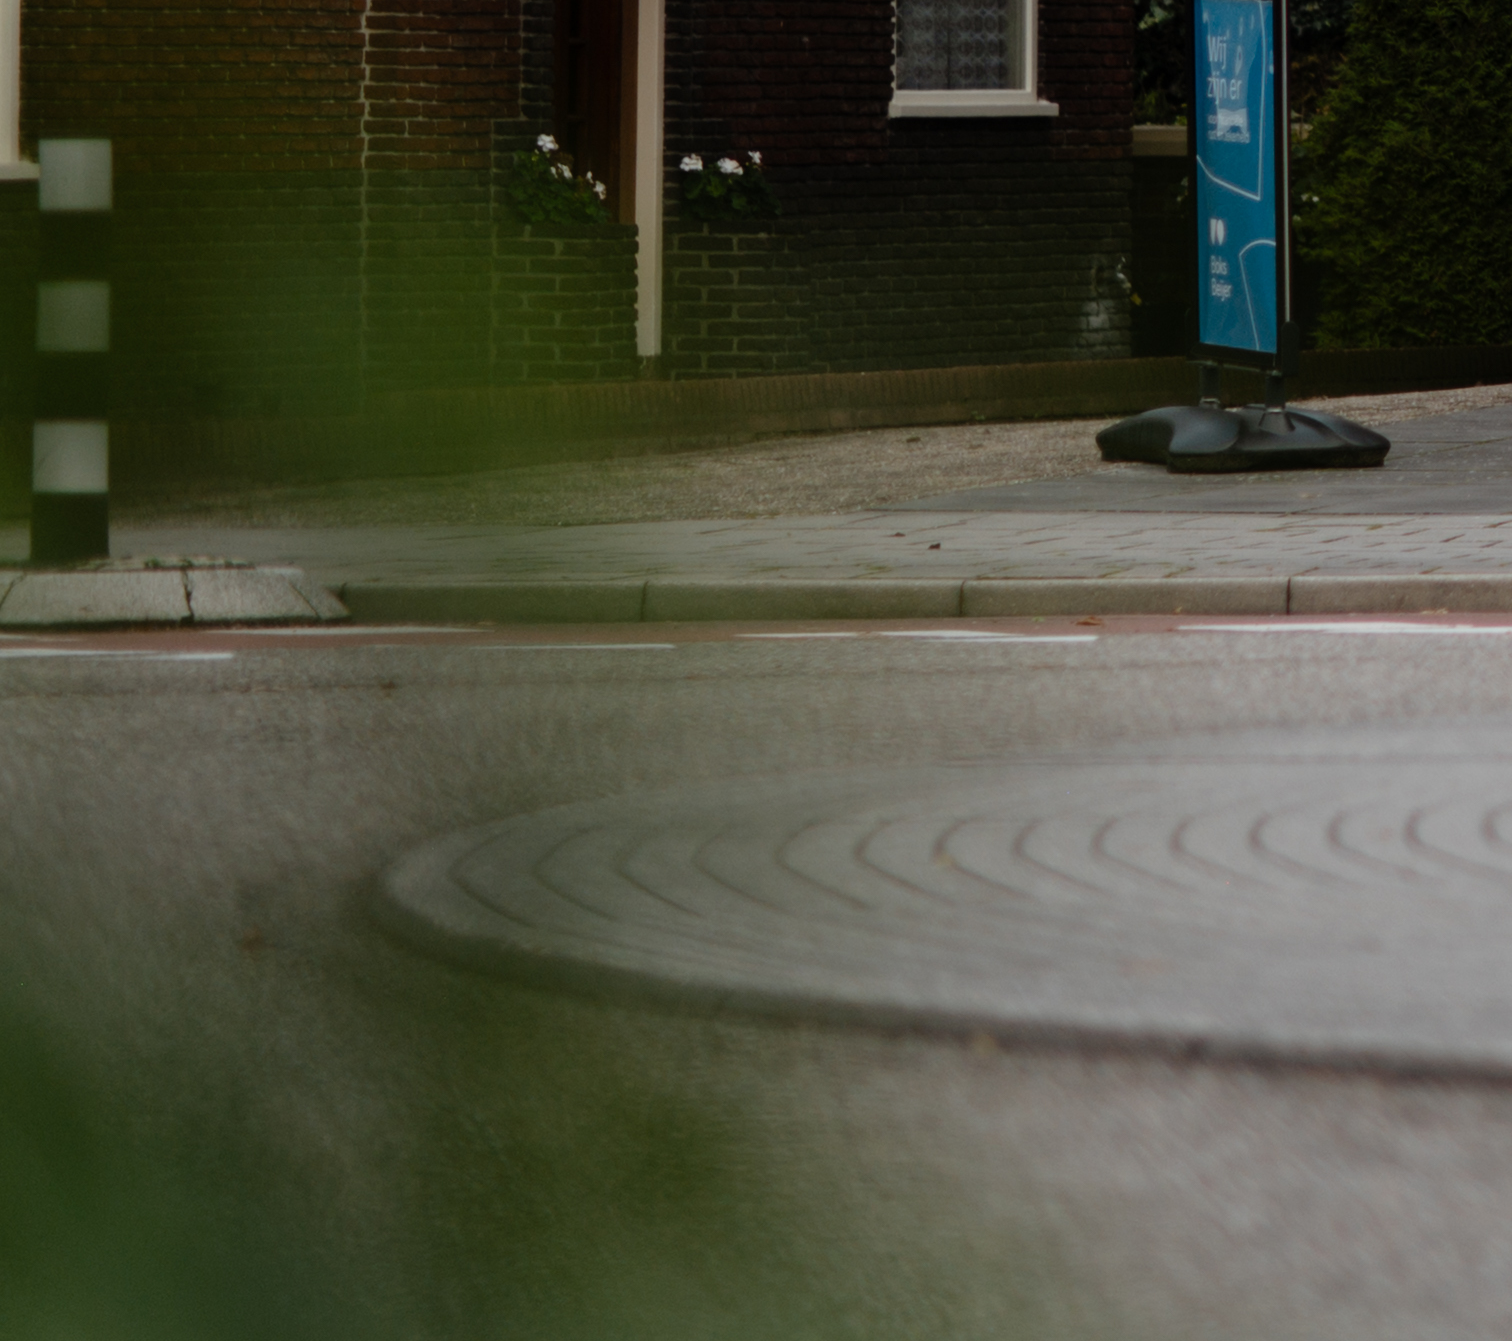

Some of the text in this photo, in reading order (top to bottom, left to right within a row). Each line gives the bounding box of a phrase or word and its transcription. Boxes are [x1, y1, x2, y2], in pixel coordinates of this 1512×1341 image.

[1207, 35, 1227, 71] Wij
[1206, 72, 1243, 105] zijn er
